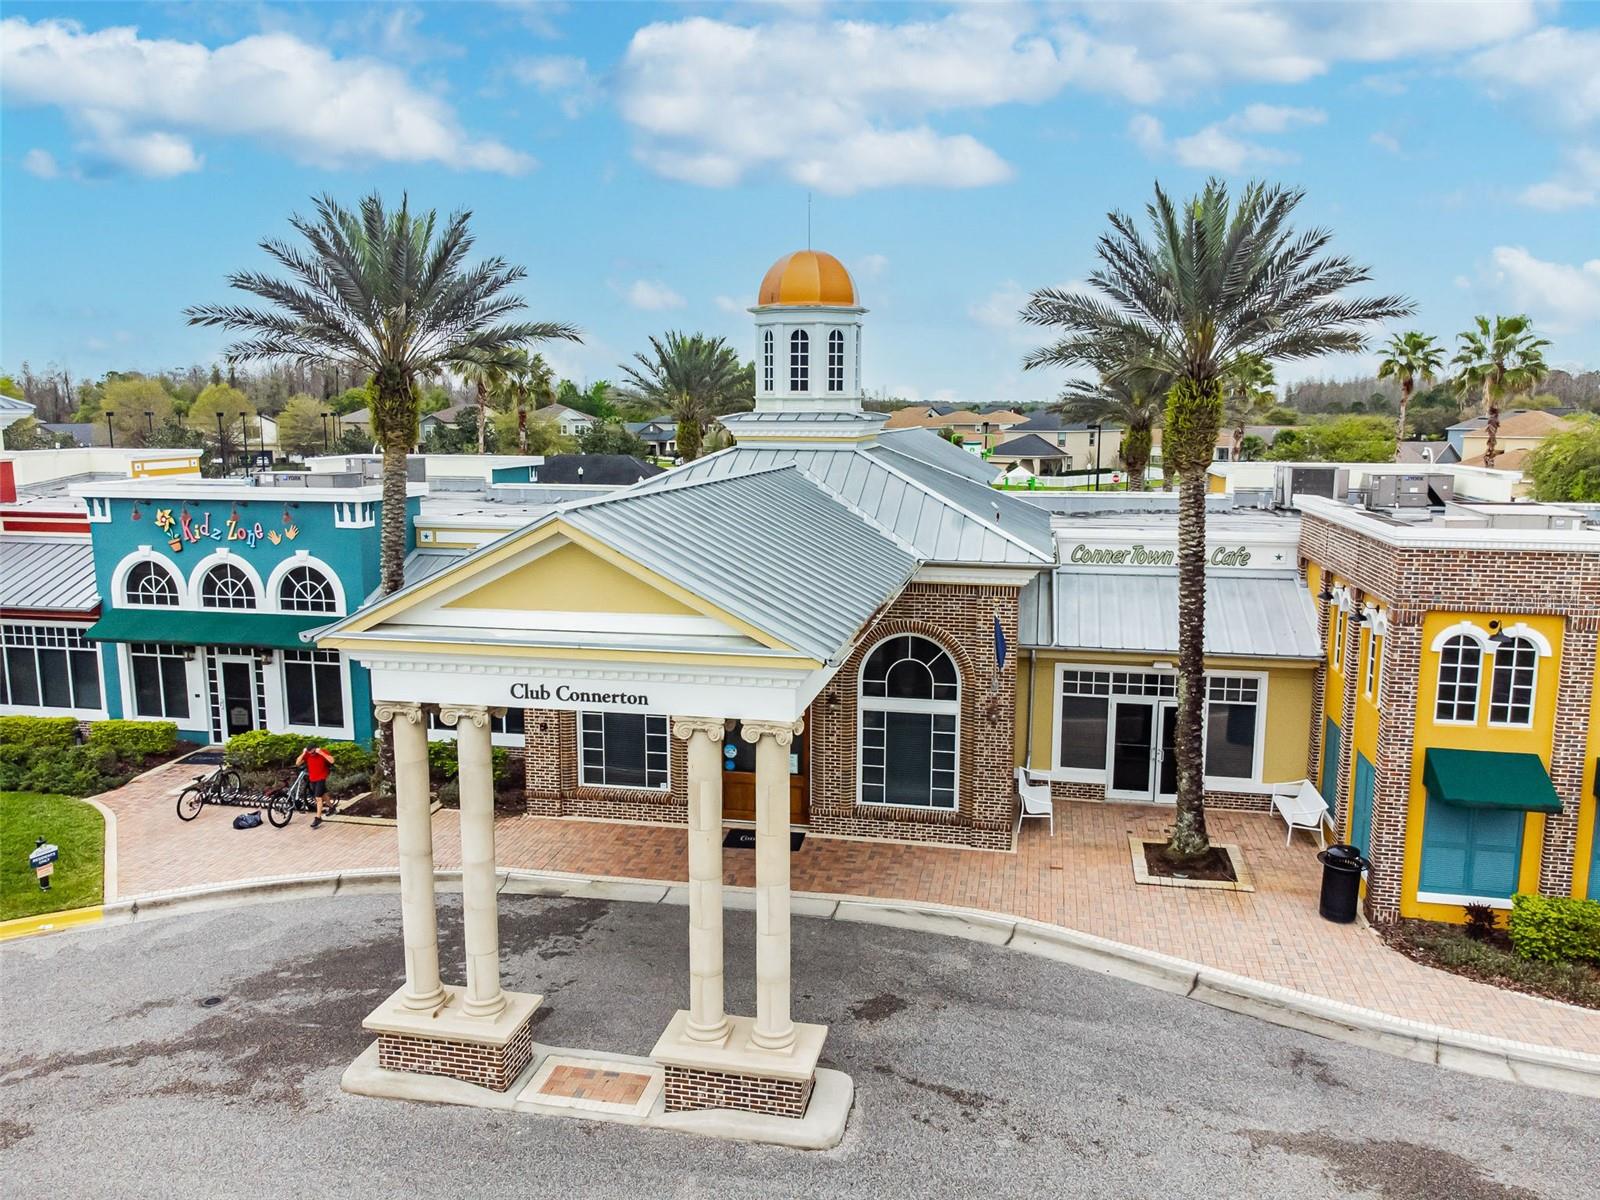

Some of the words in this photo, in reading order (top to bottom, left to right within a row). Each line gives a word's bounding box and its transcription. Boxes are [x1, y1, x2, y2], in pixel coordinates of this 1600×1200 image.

[180, 512, 222, 544] Kidz
[226, 520, 264, 548] Zone
[1210, 546, 1251, 566] Cafe
[510, 682, 550, 700] Club
[556, 685, 649, 706] Connerton
